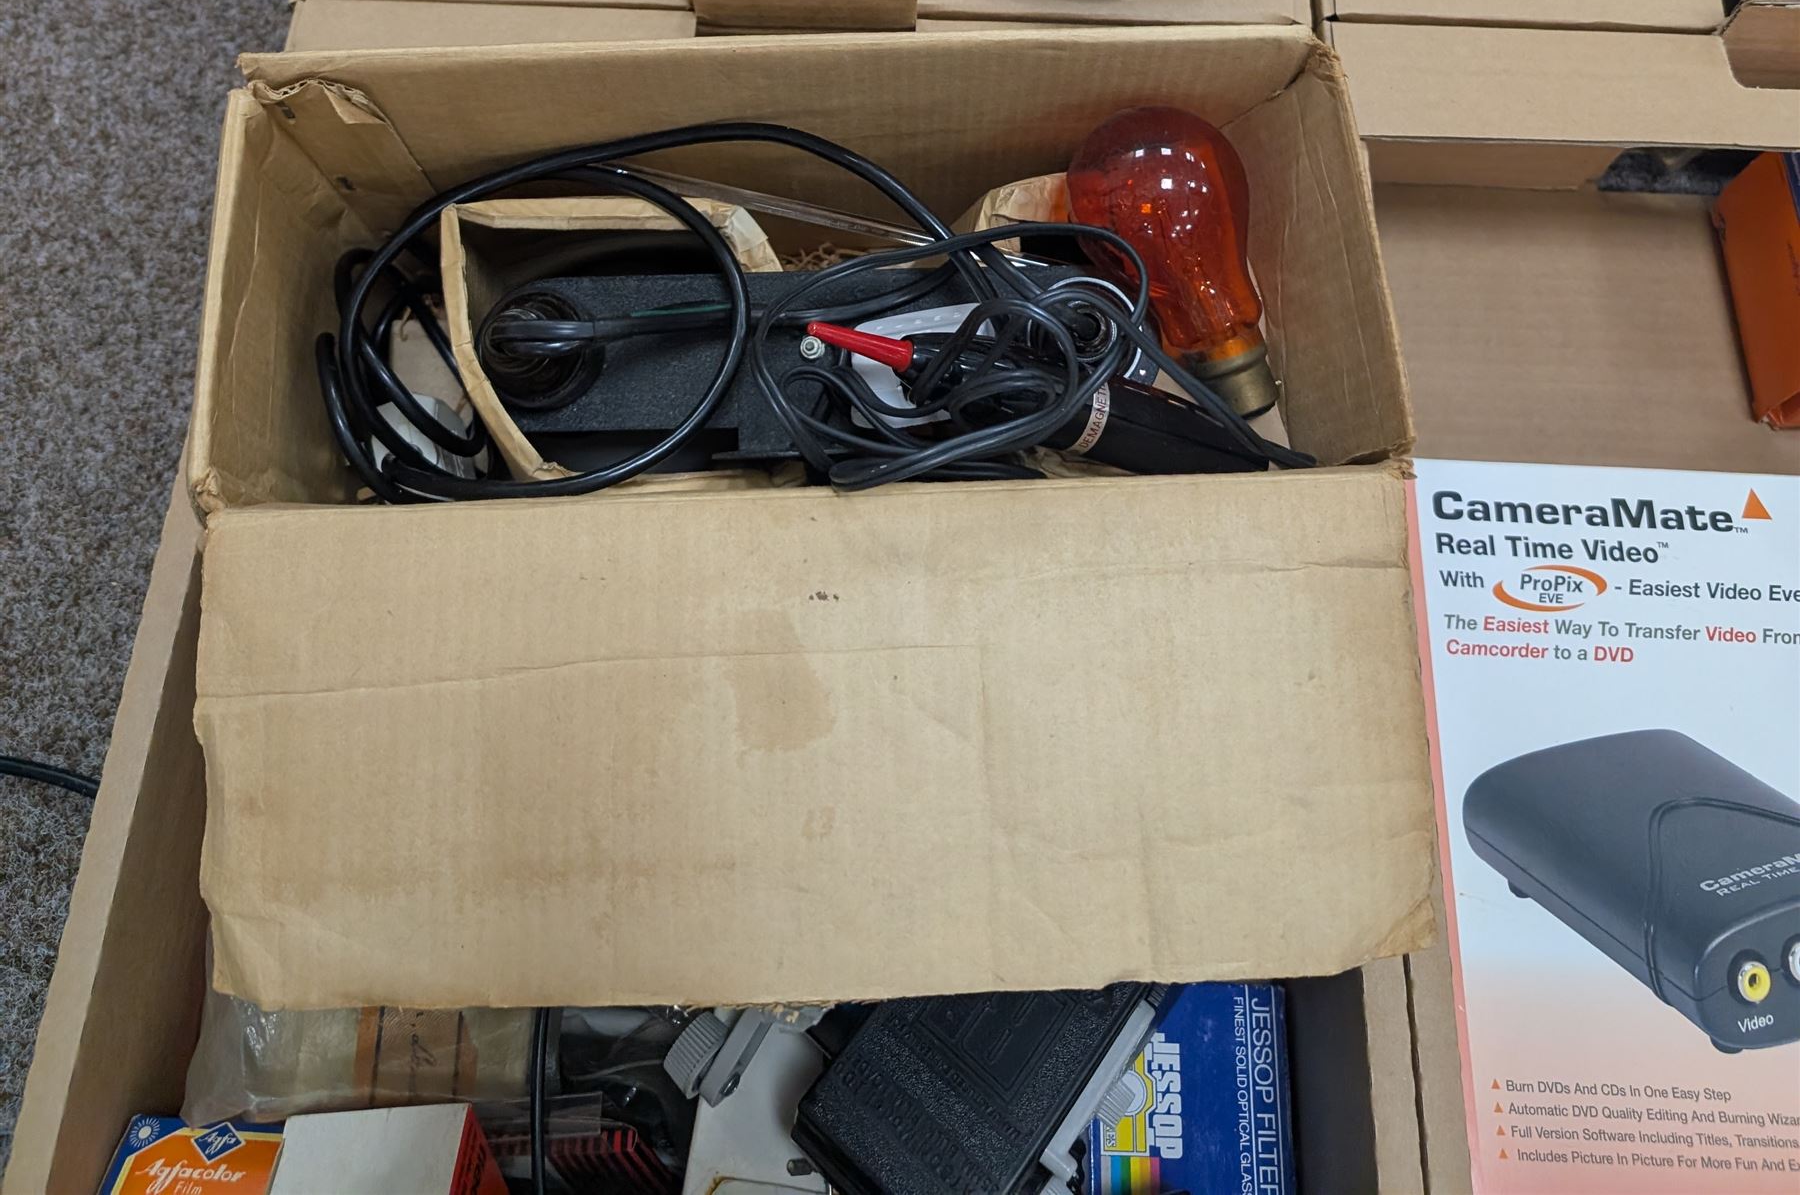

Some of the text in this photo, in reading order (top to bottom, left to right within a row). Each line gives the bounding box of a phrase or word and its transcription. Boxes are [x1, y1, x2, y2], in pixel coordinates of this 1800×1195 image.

[1432, 489, 1735, 533] CameraMate
[1435, 532, 1495, 556] Real
[1504, 535, 1573, 559] Time
[1581, 539, 1660, 564] Video
[1439, 570, 1485, 589] With
[1520, 573, 1583, 594] ProPix
[1628, 578, 1701, 598] Easiest
[1706, 582, 1762, 601] Video
[1538, 592, 1564, 604] EVE
[1444, 614, 1478, 632] The
[1483, 615, 1549, 634] Easiest
[1554, 619, 1592, 639] Way
[1598, 621, 1619, 637] To
[1624, 622, 1701, 642] Transfer
[1705, 626, 1757, 644] Video
[1446, 639, 1634, 663] Camcorder to a DVD
[1715, 866, 1800, 897] REAL TIME
[1233, 995, 1246, 1043] FINEST
[1738, 1012, 1775, 1034] Video
[1252, 997, 1275, 1104] JESSOP
[1235, 1045, 1248, 1088] SOLID
[1150, 1032, 1184, 1159] JESSOP
[1506, 1079, 1732, 1104] Burn DVDs And CDs In One Easy Step
[1237, 1089, 1251, 1150] OPTICAL
[1508, 1102, 1569, 1118] Automatic
[1572, 1103, 1599, 1118] DVD
[1601, 1105, 1643, 1124] Quality
[1646, 1108, 1688, 1125] Editing
[1691, 1109, 1716, 1123] And
[1718, 1110, 1766, 1127] Burning
[199, 1131, 237, 1155] Agfa
[1511, 1125, 1533, 1140] Full
[1535, 1126, 1580, 1141] Version
[1582, 1127, 1636, 1143] Software
[1638, 1130, 1694, 1148] Including
[1696, 1132, 1733, 1148] Titles,
[1517, 1148, 1569, 1163] Includes
[1571, 1149, 1614, 1165] Picture
[1616, 1151, 1629, 1166] In
[1631, 1152, 1674, 1167] Picture
[1676, 1154, 1698, 1168] For
[1700, 1155, 1732, 1170] More
[1734, 1157, 1758, 1171] Fun
[1761, 1158, 1786, 1172] And
[135, 1158, 247, 1195] Agfacolor
[174, 1179, 203, 1195] Film
